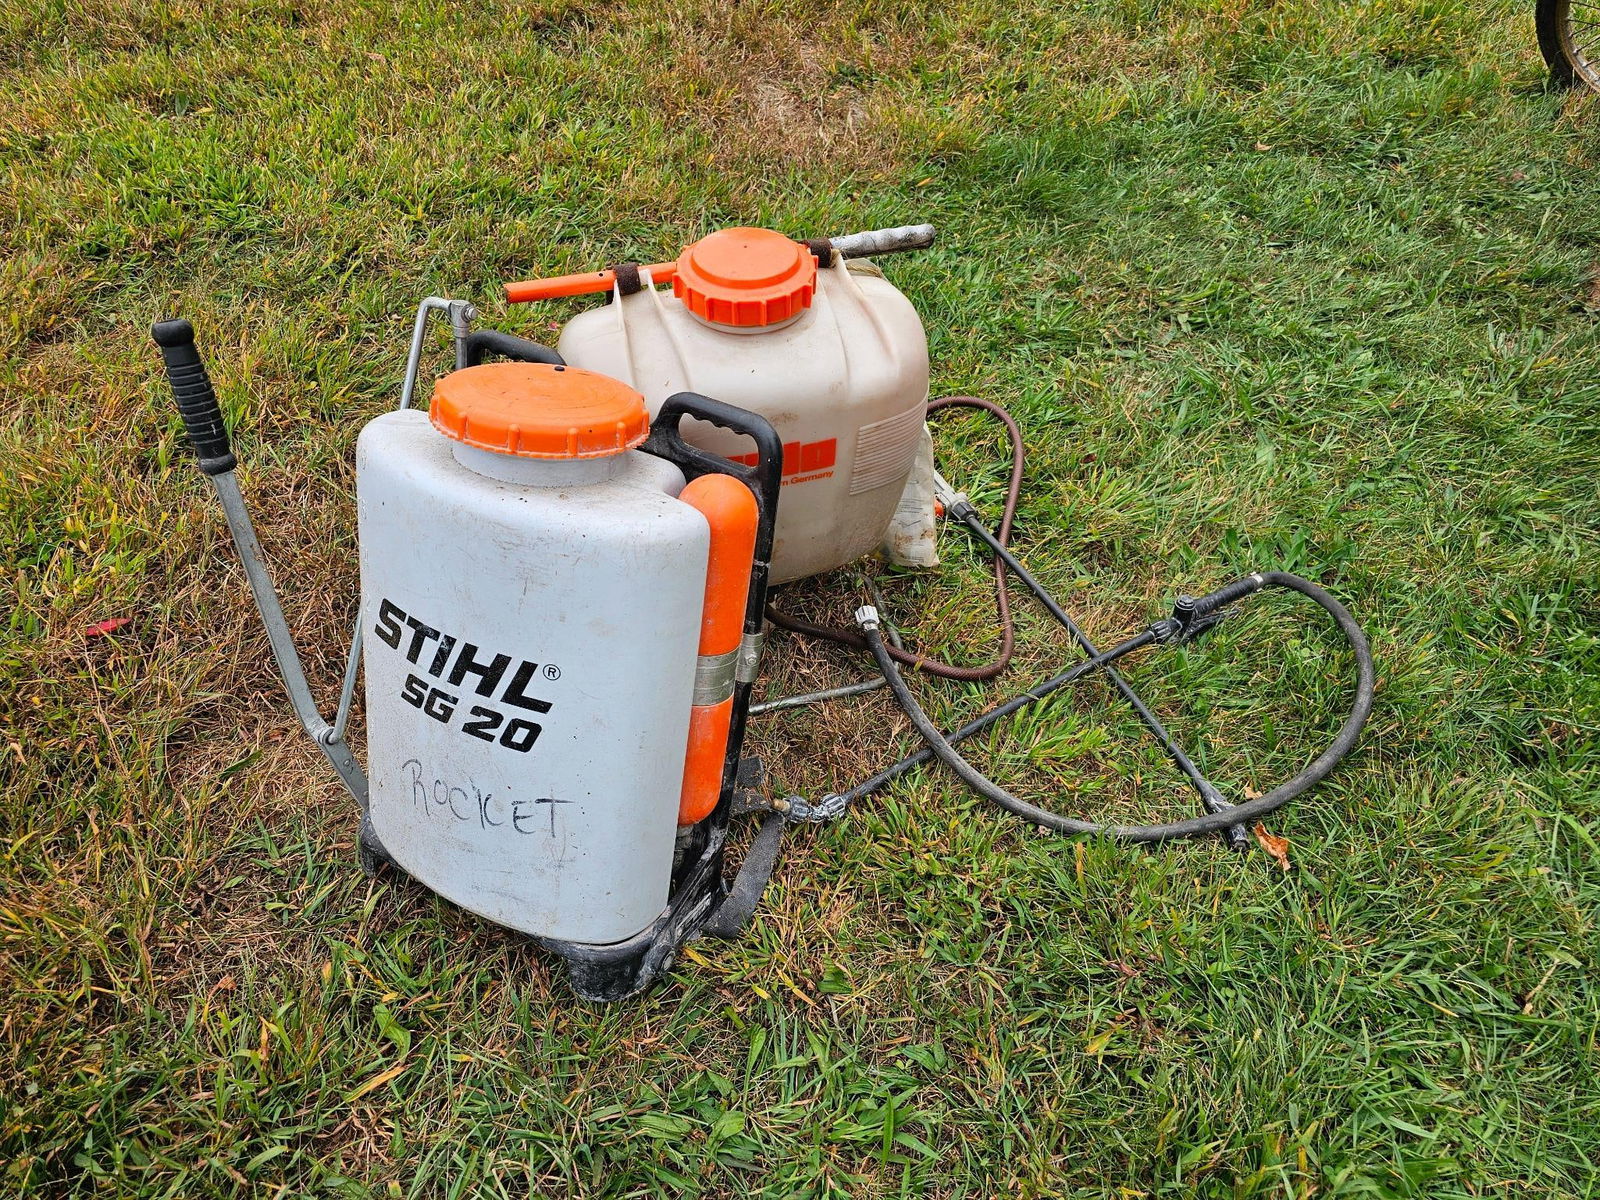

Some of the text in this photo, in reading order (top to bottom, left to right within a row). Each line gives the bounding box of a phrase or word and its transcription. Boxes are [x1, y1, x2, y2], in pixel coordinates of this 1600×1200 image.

[791, 471, 834, 485] Germany
[400, 673, 542, 753] SG 20
[402, 758, 575, 838] ROCKET
